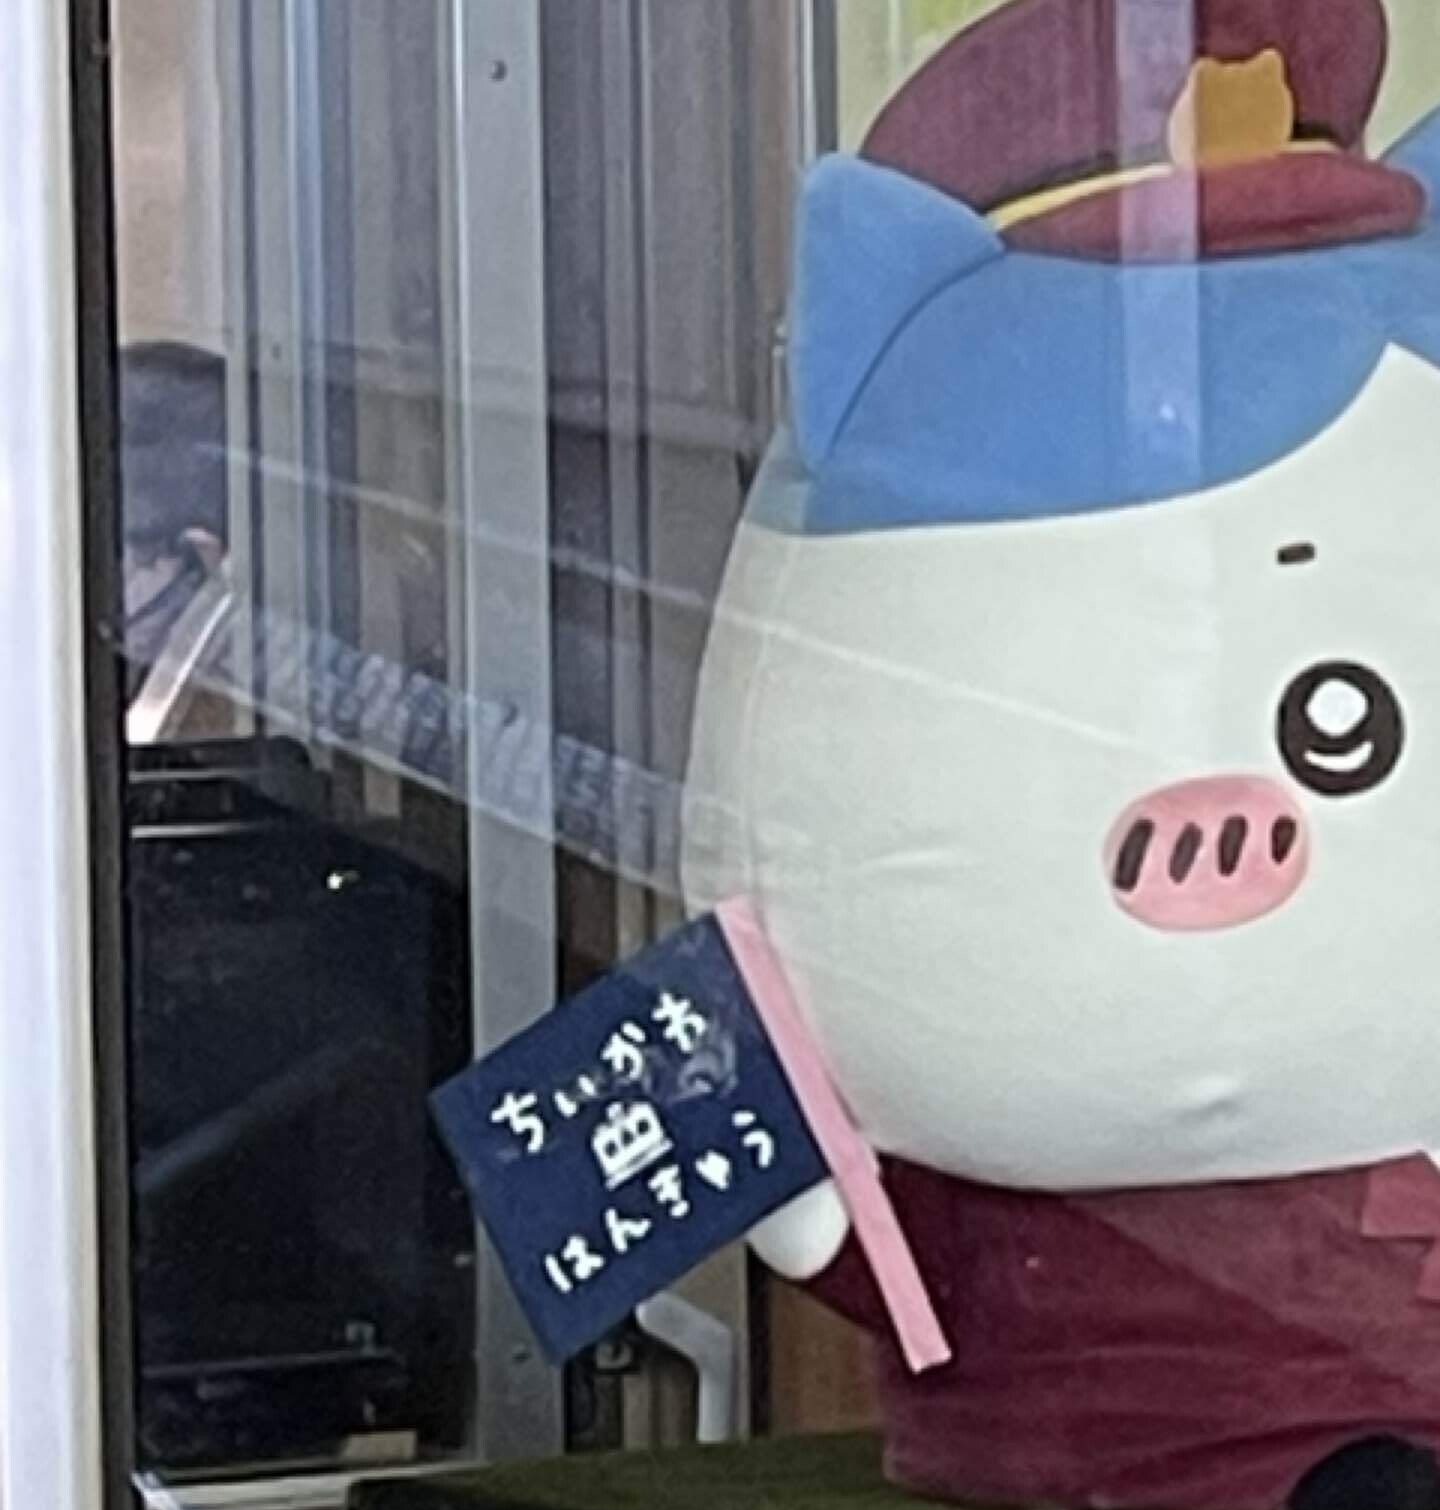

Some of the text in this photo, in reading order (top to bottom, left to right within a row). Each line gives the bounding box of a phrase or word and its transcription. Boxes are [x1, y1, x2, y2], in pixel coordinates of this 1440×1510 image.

[489, 991, 708, 1154] ちいかわ
[543, 1109, 776, 1293] はんきゅう
